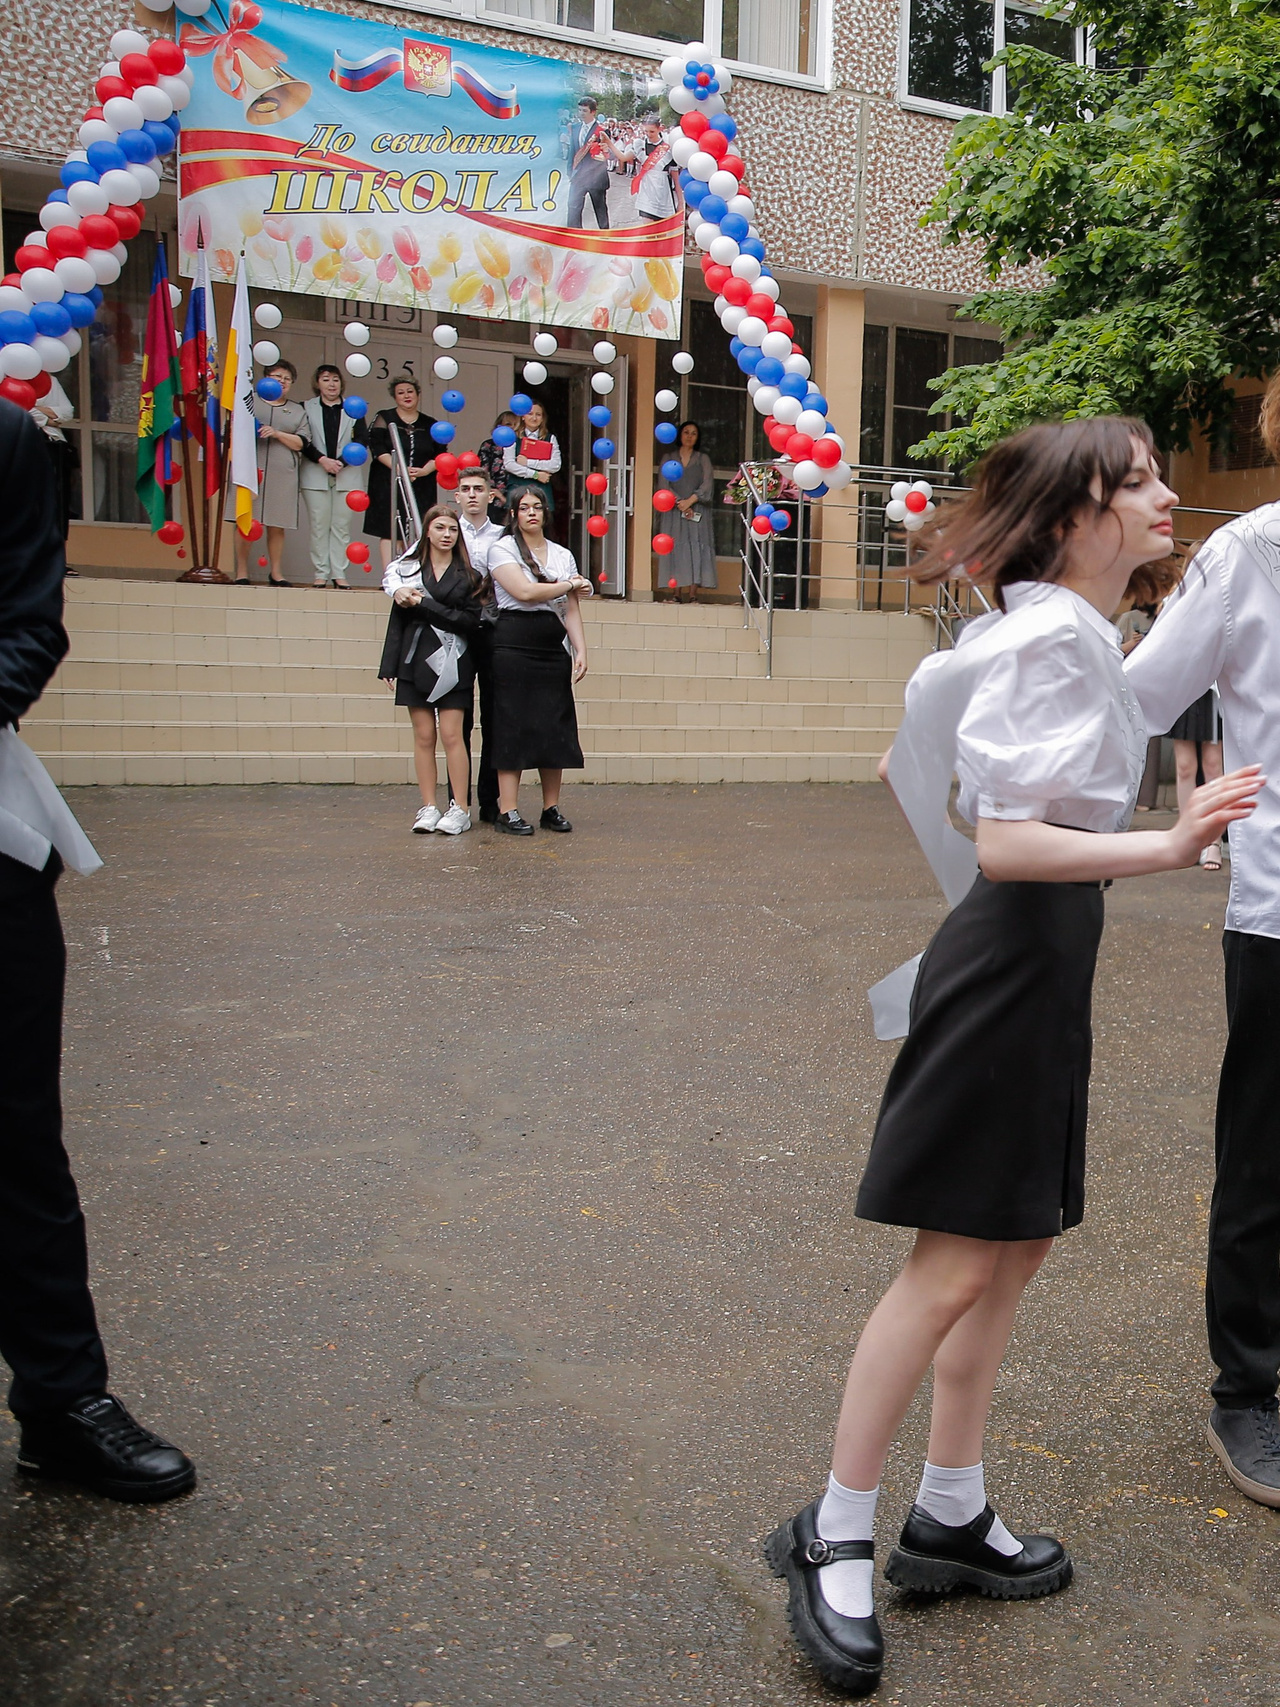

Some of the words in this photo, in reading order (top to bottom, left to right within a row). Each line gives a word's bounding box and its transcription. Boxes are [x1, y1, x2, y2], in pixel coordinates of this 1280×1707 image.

[295, 124, 356, 158] До
[371, 126, 542, 159] свидания,
[263, 170, 561, 214] ШКОЛА!
